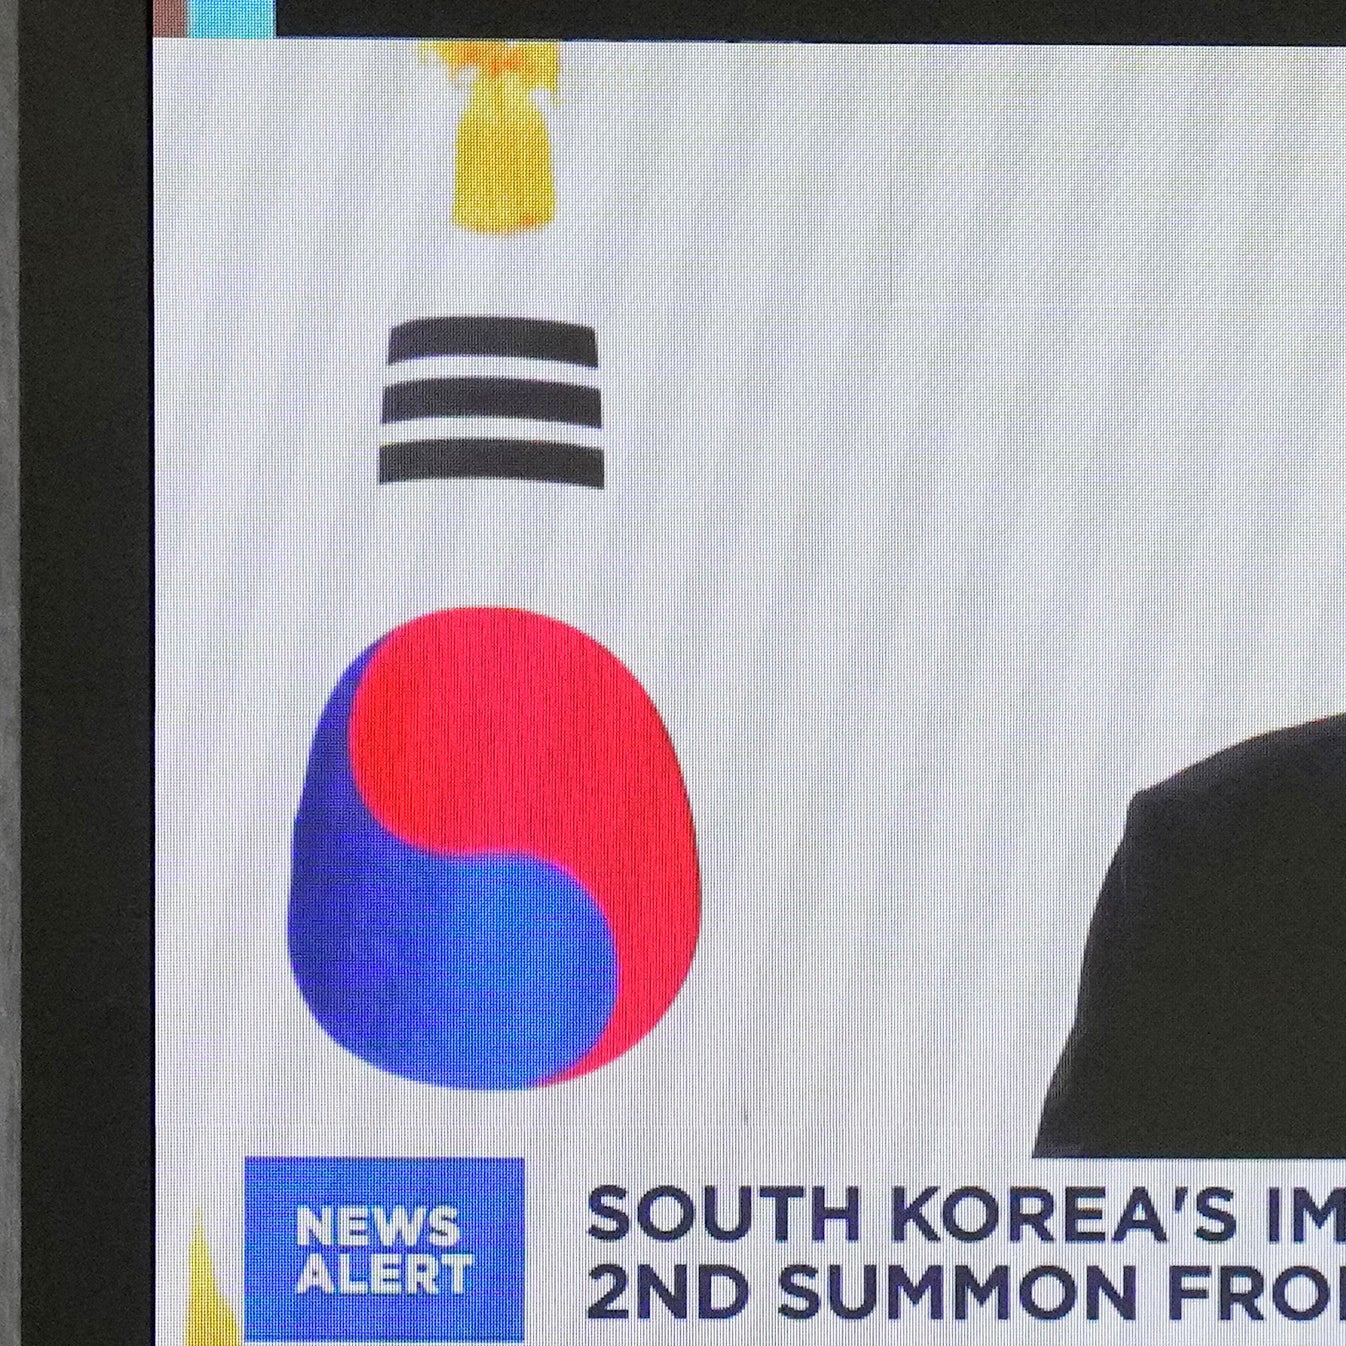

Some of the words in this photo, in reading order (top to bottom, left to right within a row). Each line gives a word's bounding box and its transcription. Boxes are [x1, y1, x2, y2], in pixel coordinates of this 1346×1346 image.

[296, 1206, 461, 1247] NEWS
[588, 1184, 861, 1243] SOUTH
[891, 1186, 1238, 1244] KOREA'S
[296, 1253, 474, 1294] ALERT
[587, 1262, 751, 1321] 2ND
[777, 1263, 1137, 1322] SUMMON
